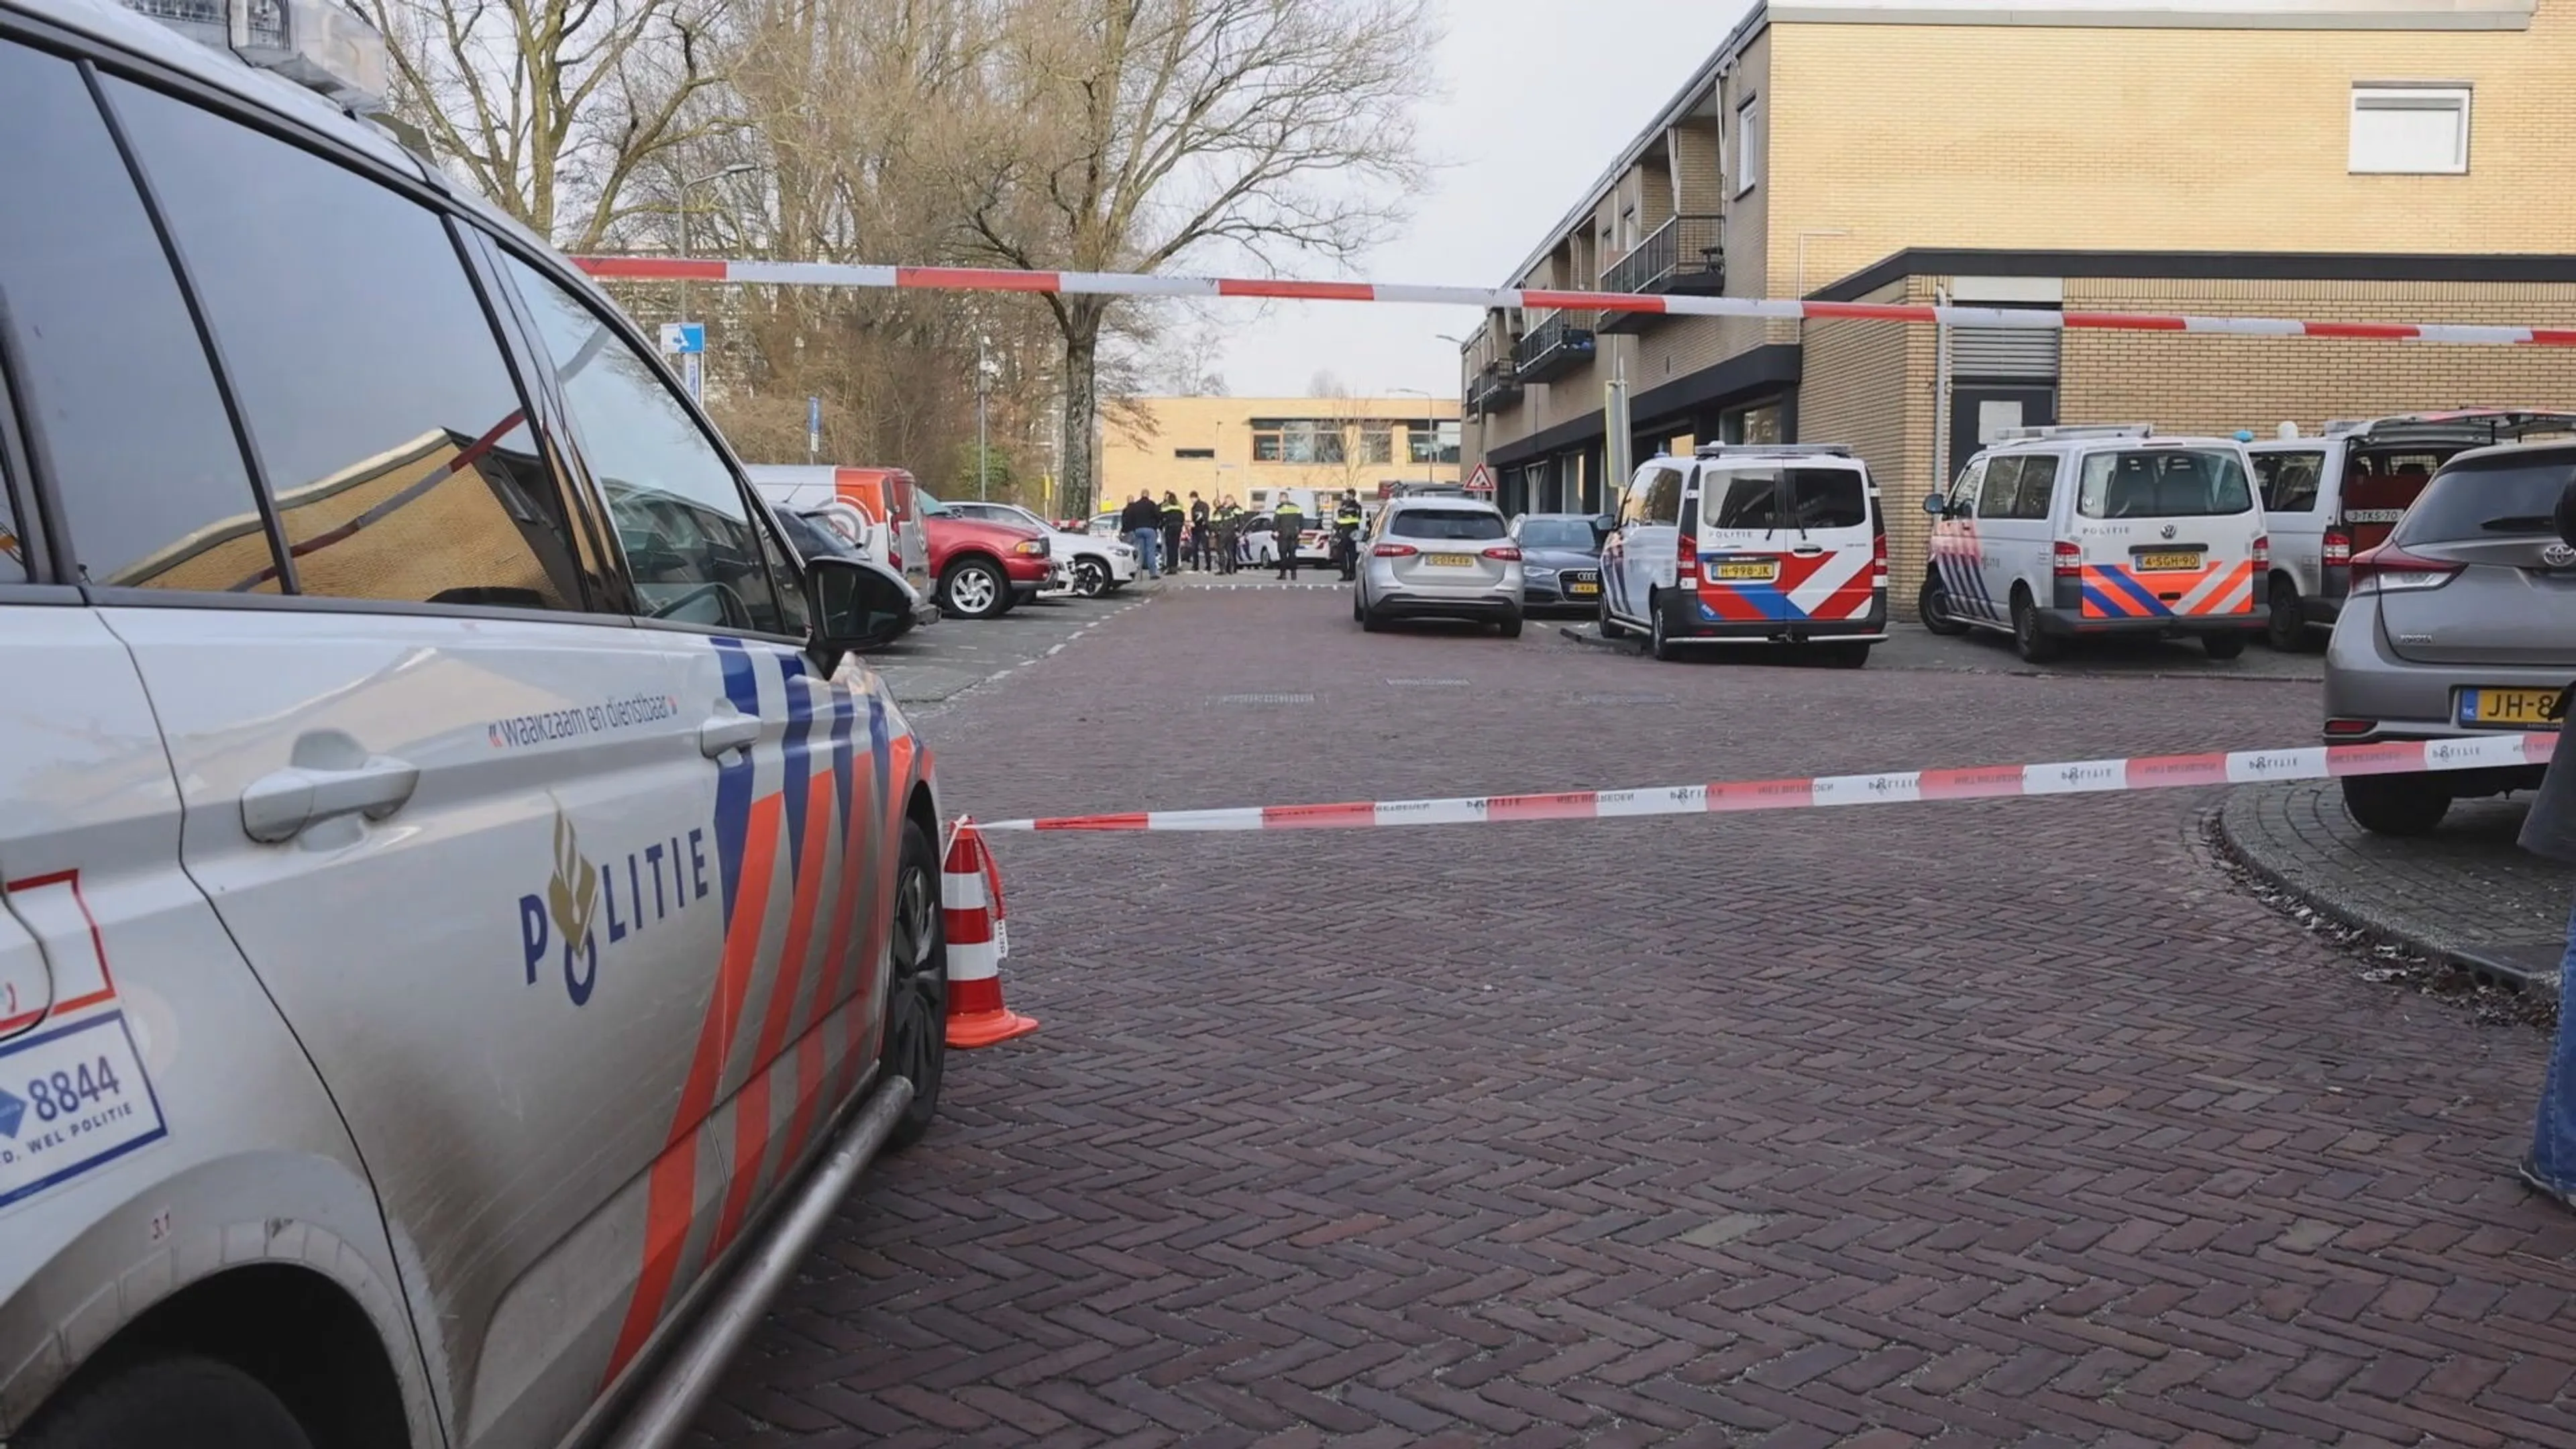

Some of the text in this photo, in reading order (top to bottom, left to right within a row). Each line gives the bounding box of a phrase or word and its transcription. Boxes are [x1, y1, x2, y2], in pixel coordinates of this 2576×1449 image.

[1709, 530, 1752, 539] POLITIE
[2082, 526, 2131, 535] POLITIE
[586, 705, 608, 732] en
[519, 827, 708, 1007] POLITIE
[28, 1055, 120, 1122] 8844
[26, 1131, 65, 1153] WEL
[69, 1102, 133, 1136] POLITIE
